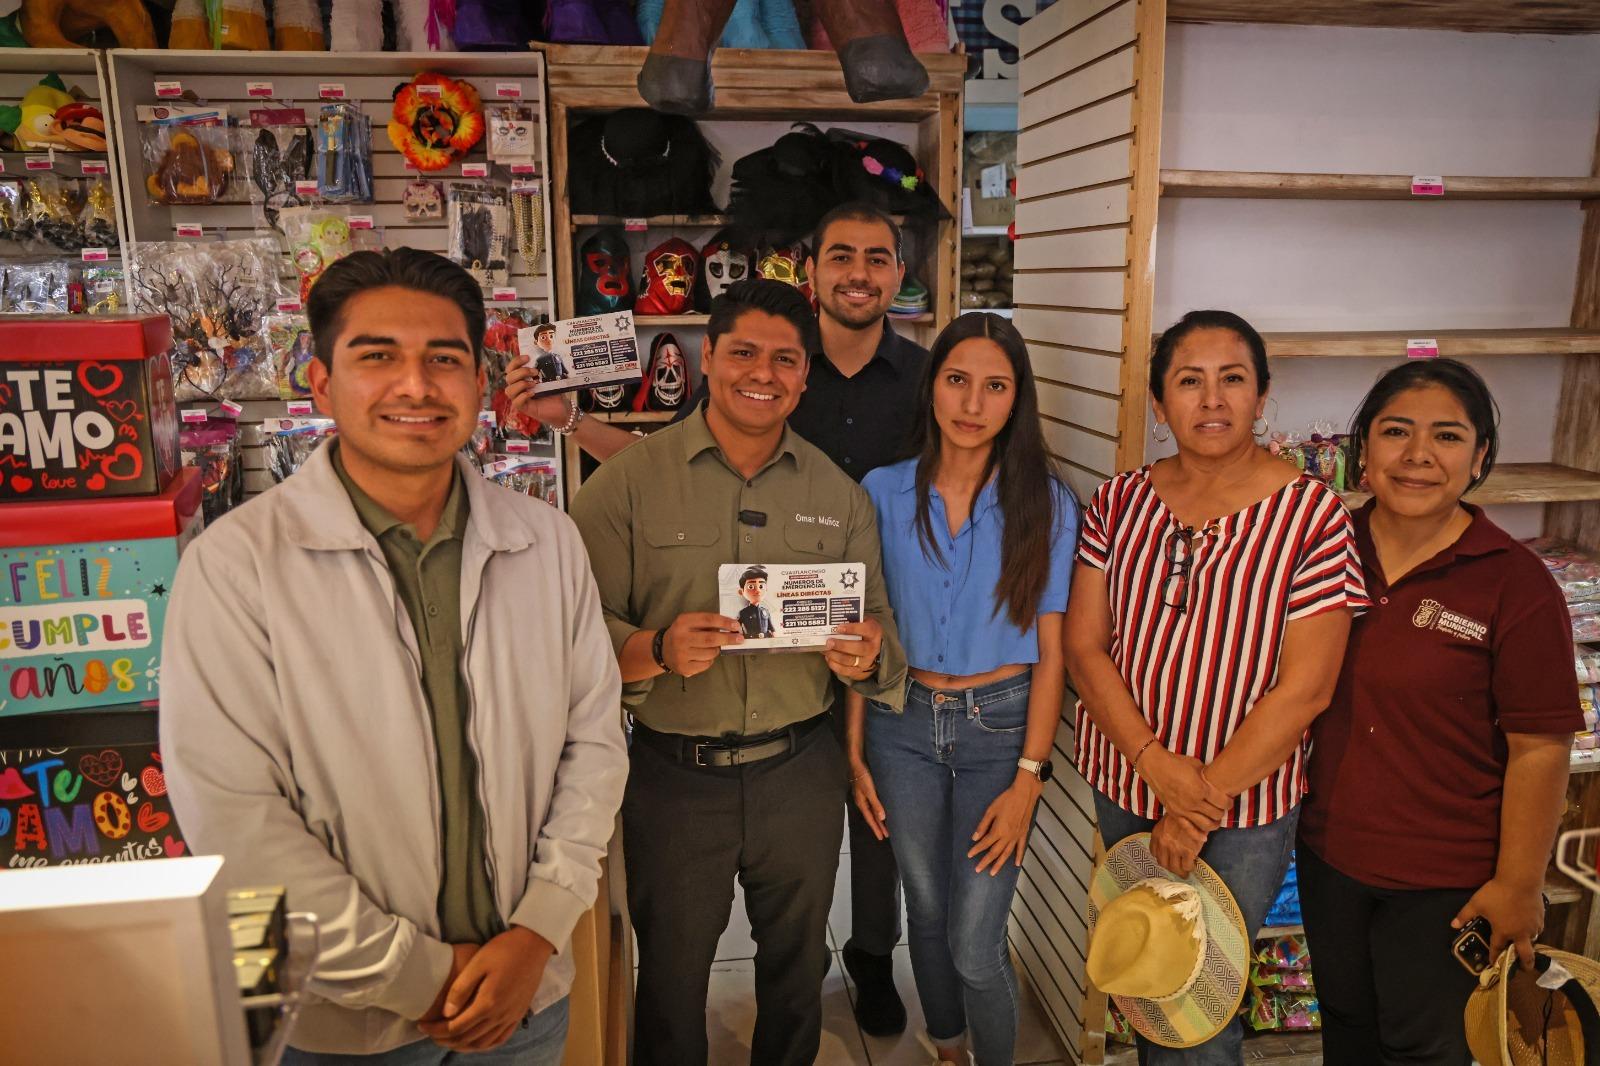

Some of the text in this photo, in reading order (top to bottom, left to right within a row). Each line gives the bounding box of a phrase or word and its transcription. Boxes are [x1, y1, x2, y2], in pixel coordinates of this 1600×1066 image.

[6, 370, 75, 411] TE
[0, 411, 115, 469] AMO
[41, 472, 77, 490] love
[795, 513, 816, 523] Omar
[9, 557, 113, 603] FELIZ
[1438, 617, 1483, 640] MUNICIPAL
[1441, 611, 1487, 634] GOBIERNO
[9, 657, 142, 699] años
